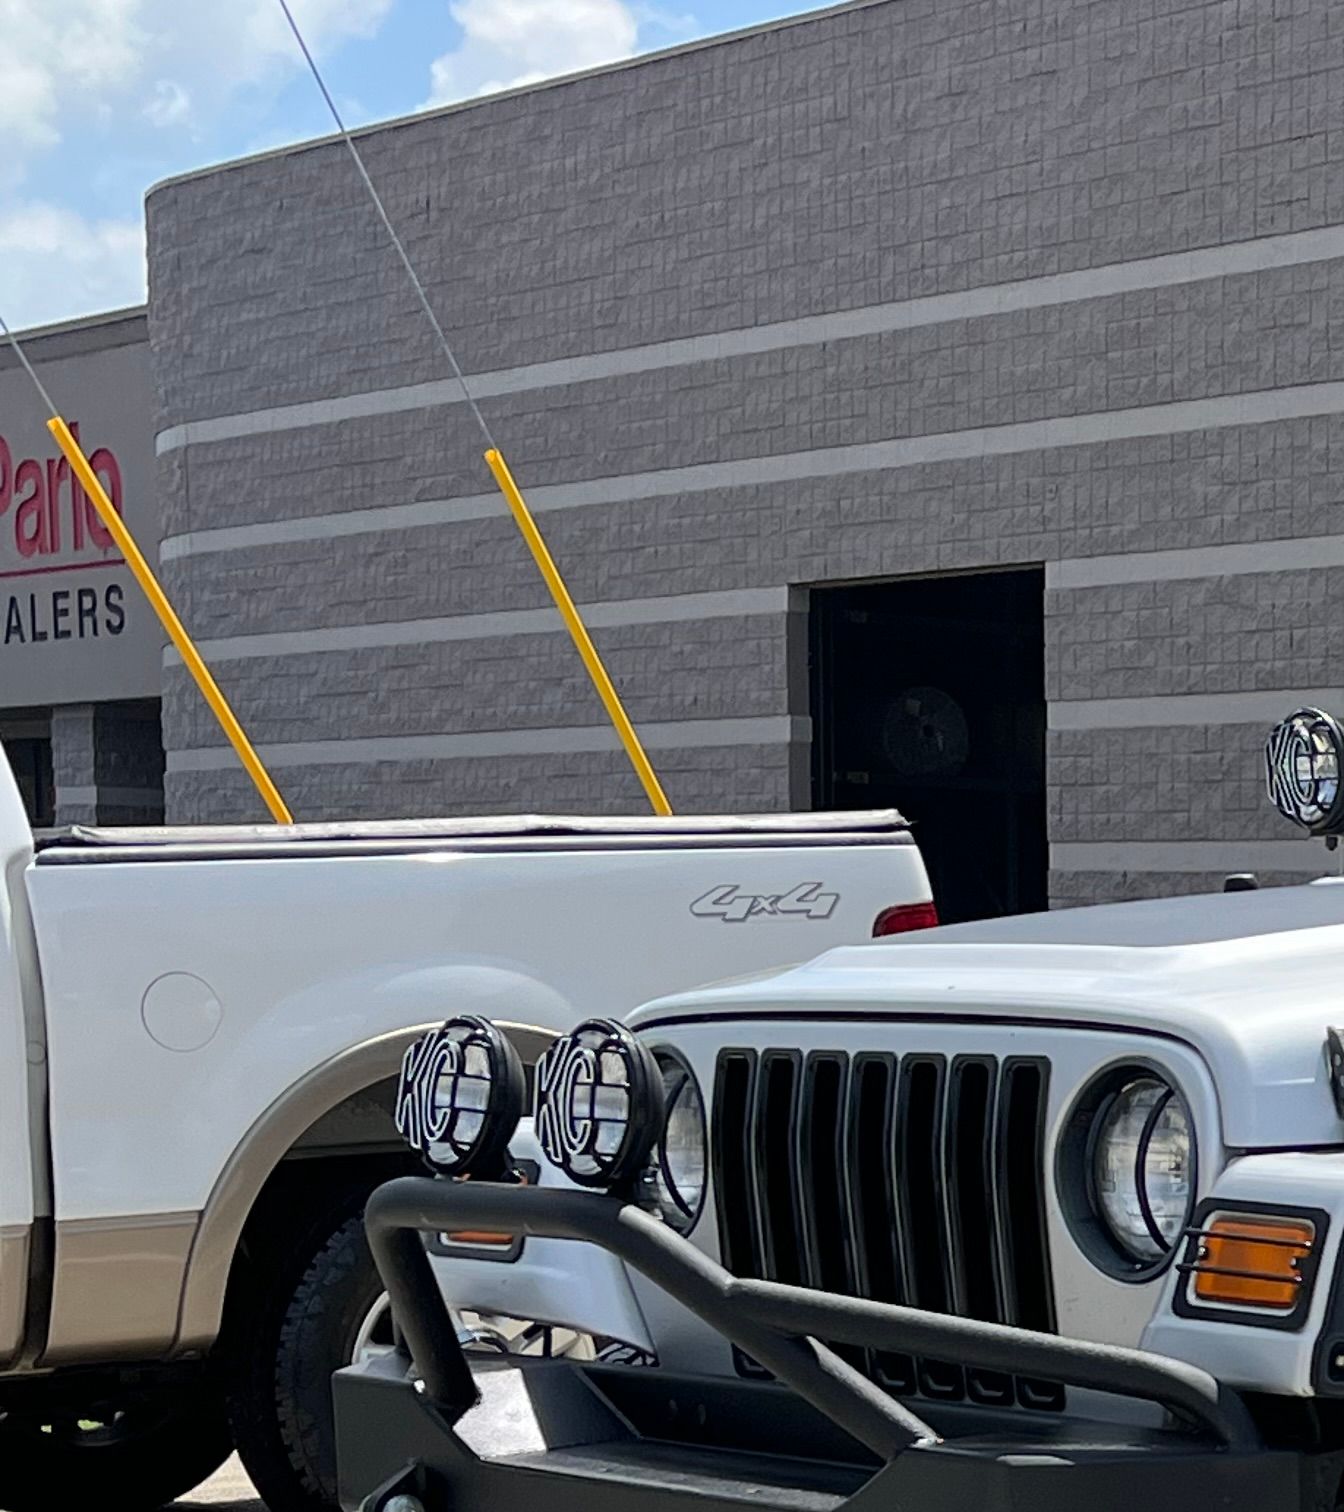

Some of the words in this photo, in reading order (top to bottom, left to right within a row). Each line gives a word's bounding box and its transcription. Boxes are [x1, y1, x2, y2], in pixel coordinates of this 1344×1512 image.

[4, 584, 125, 644] ALERS
[690, 882, 840, 923] 4x4
[395, 1028, 460, 1150] KC
[533, 1036, 596, 1163] KC
